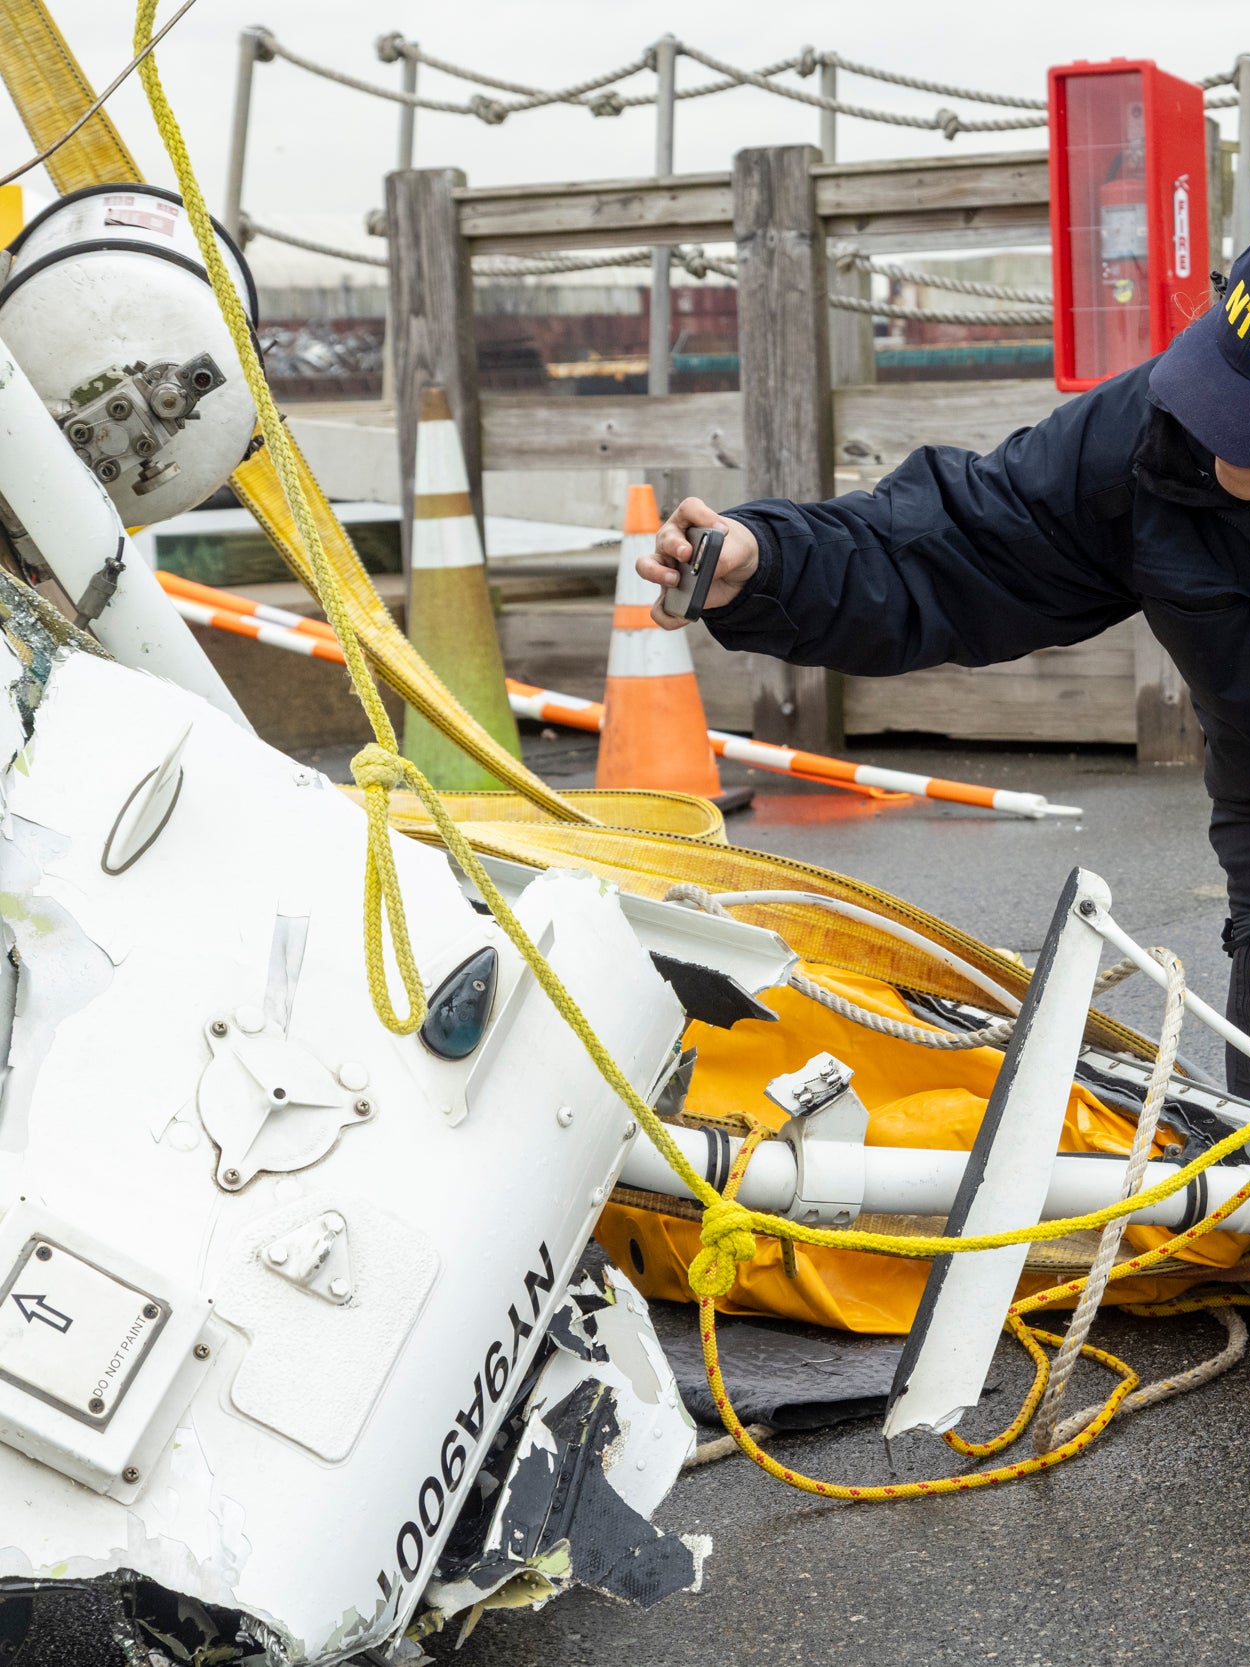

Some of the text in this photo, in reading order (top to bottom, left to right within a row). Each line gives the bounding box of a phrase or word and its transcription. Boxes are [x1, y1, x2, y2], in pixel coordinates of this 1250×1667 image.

[1178, 200, 1186, 270] FIRE
[92, 1315, 146, 1398] DO NOT PAINT
